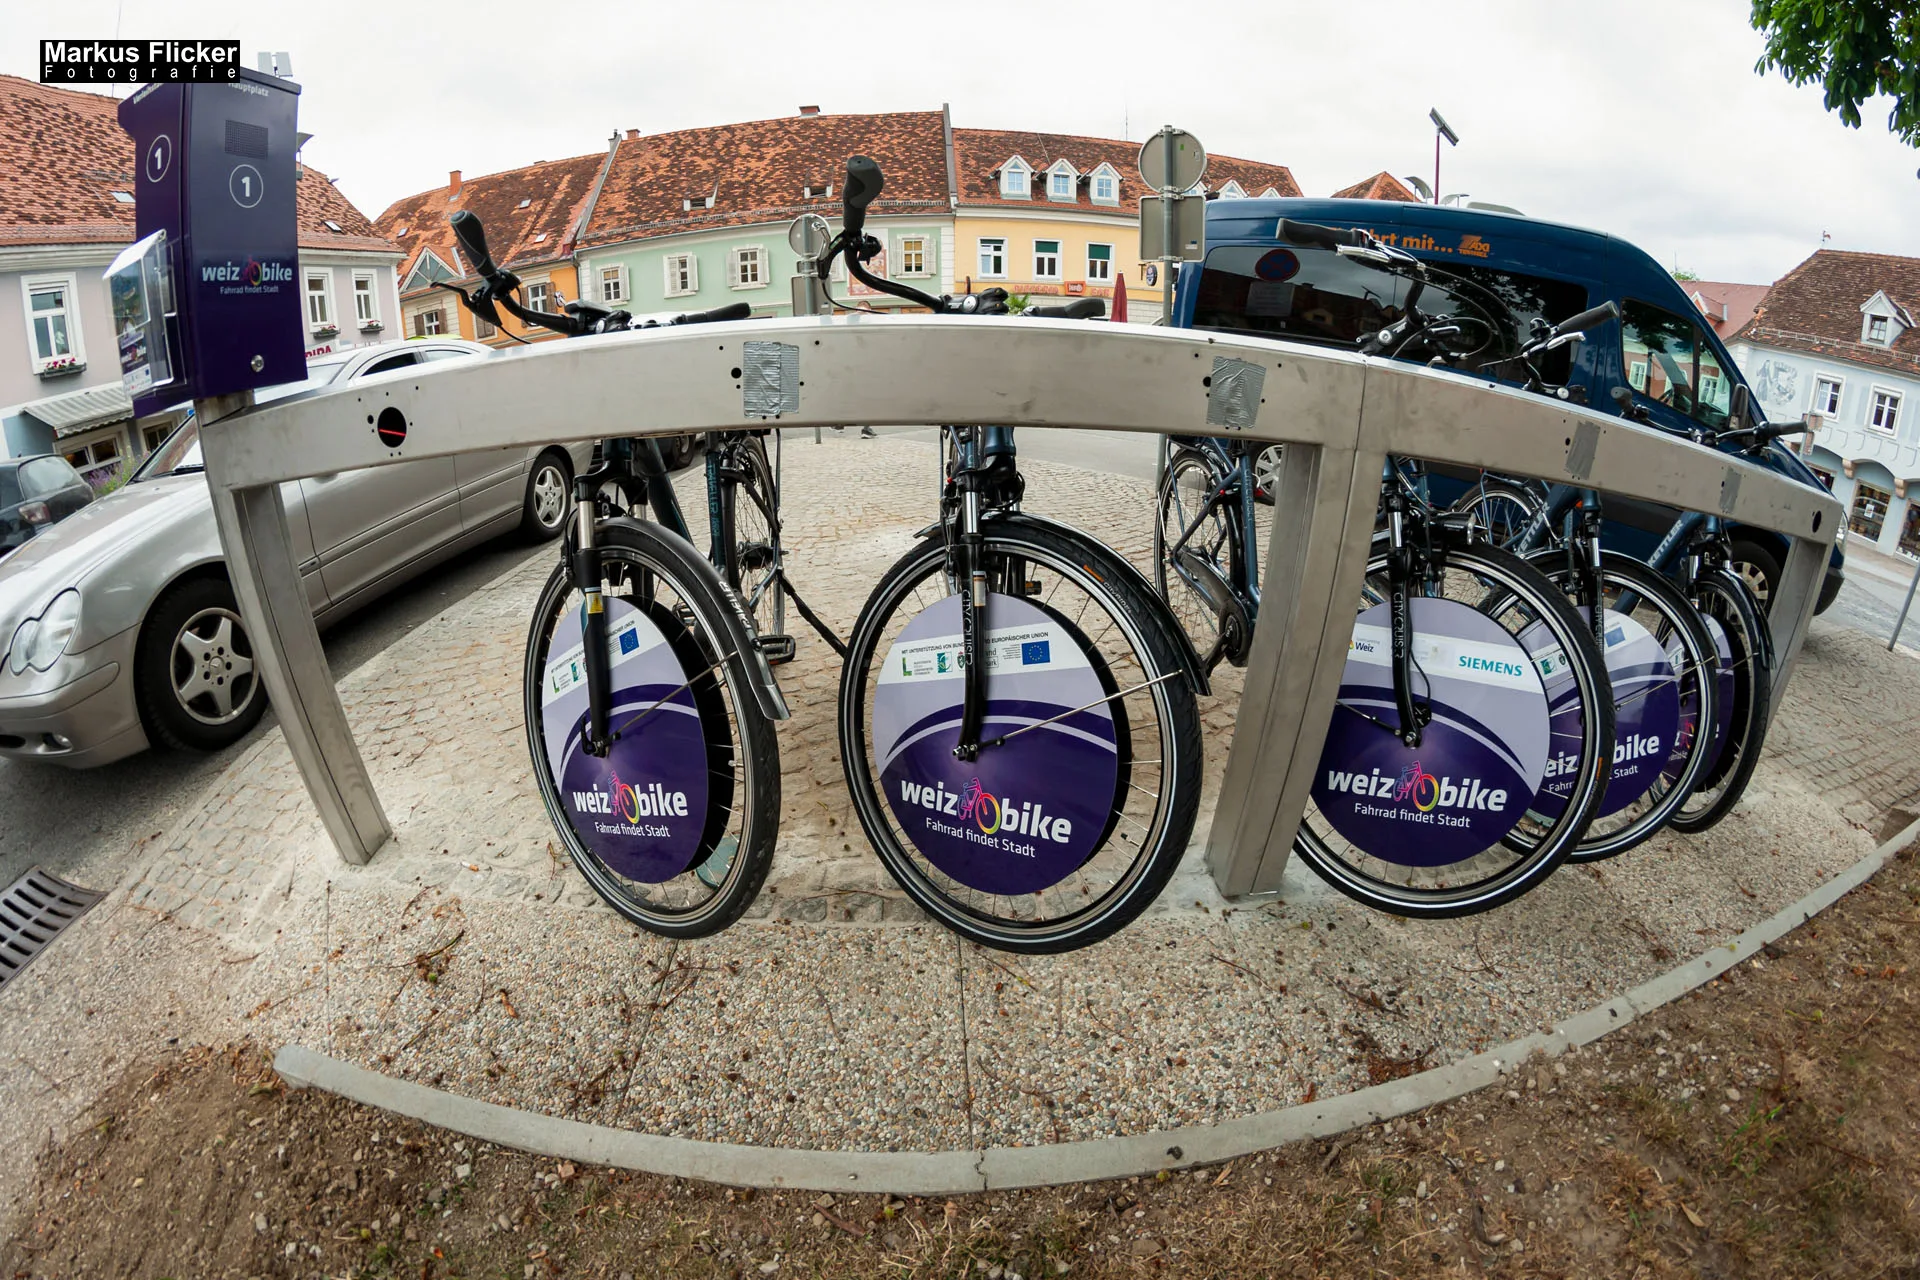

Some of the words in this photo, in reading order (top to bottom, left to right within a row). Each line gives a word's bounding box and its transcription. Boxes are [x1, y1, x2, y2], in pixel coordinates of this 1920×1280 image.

[154, 147, 162, 170] 1
[241, 176, 251, 198] 1
[202, 261, 240, 282] weiz
[261, 262, 293, 281] bike
[220, 286, 244, 295] Fahrrad
[245, 285, 262, 294] findet
[263, 285, 279, 293] Stadt
[1647, 519, 1684, 568] KETTLER
[991, 633, 1031, 643] EUROPÄISCHER
[1031, 631, 1049, 639] UNION
[1355, 641, 1374, 653] Weiz
[1459, 655, 1523, 677] SIEMENS
[1544, 751, 1578, 778] eiz
[1612, 733, 1660, 764] bike
[1613, 765, 1639, 779] Stadt
[573, 783, 612, 814] weiz
[635, 783, 688, 817] bike
[1328, 767, 1395, 799] weiz
[1437, 776, 1508, 812] bike
[901, 780, 959, 816] weiz
[1000, 798, 1072, 844] bike
[1354, 803, 1397, 819] Fahrrad
[1400, 808, 1434, 824] findet
[1437, 813, 1471, 828] Stadt
[595, 821, 621, 835] Fahrrad
[621, 823, 643, 837] findet
[645, 824, 671, 838] Stadt
[926, 817, 963, 839] Fahrrad
[966, 827, 1000, 849] findet
[1002, 838, 1036, 858] Stadt
